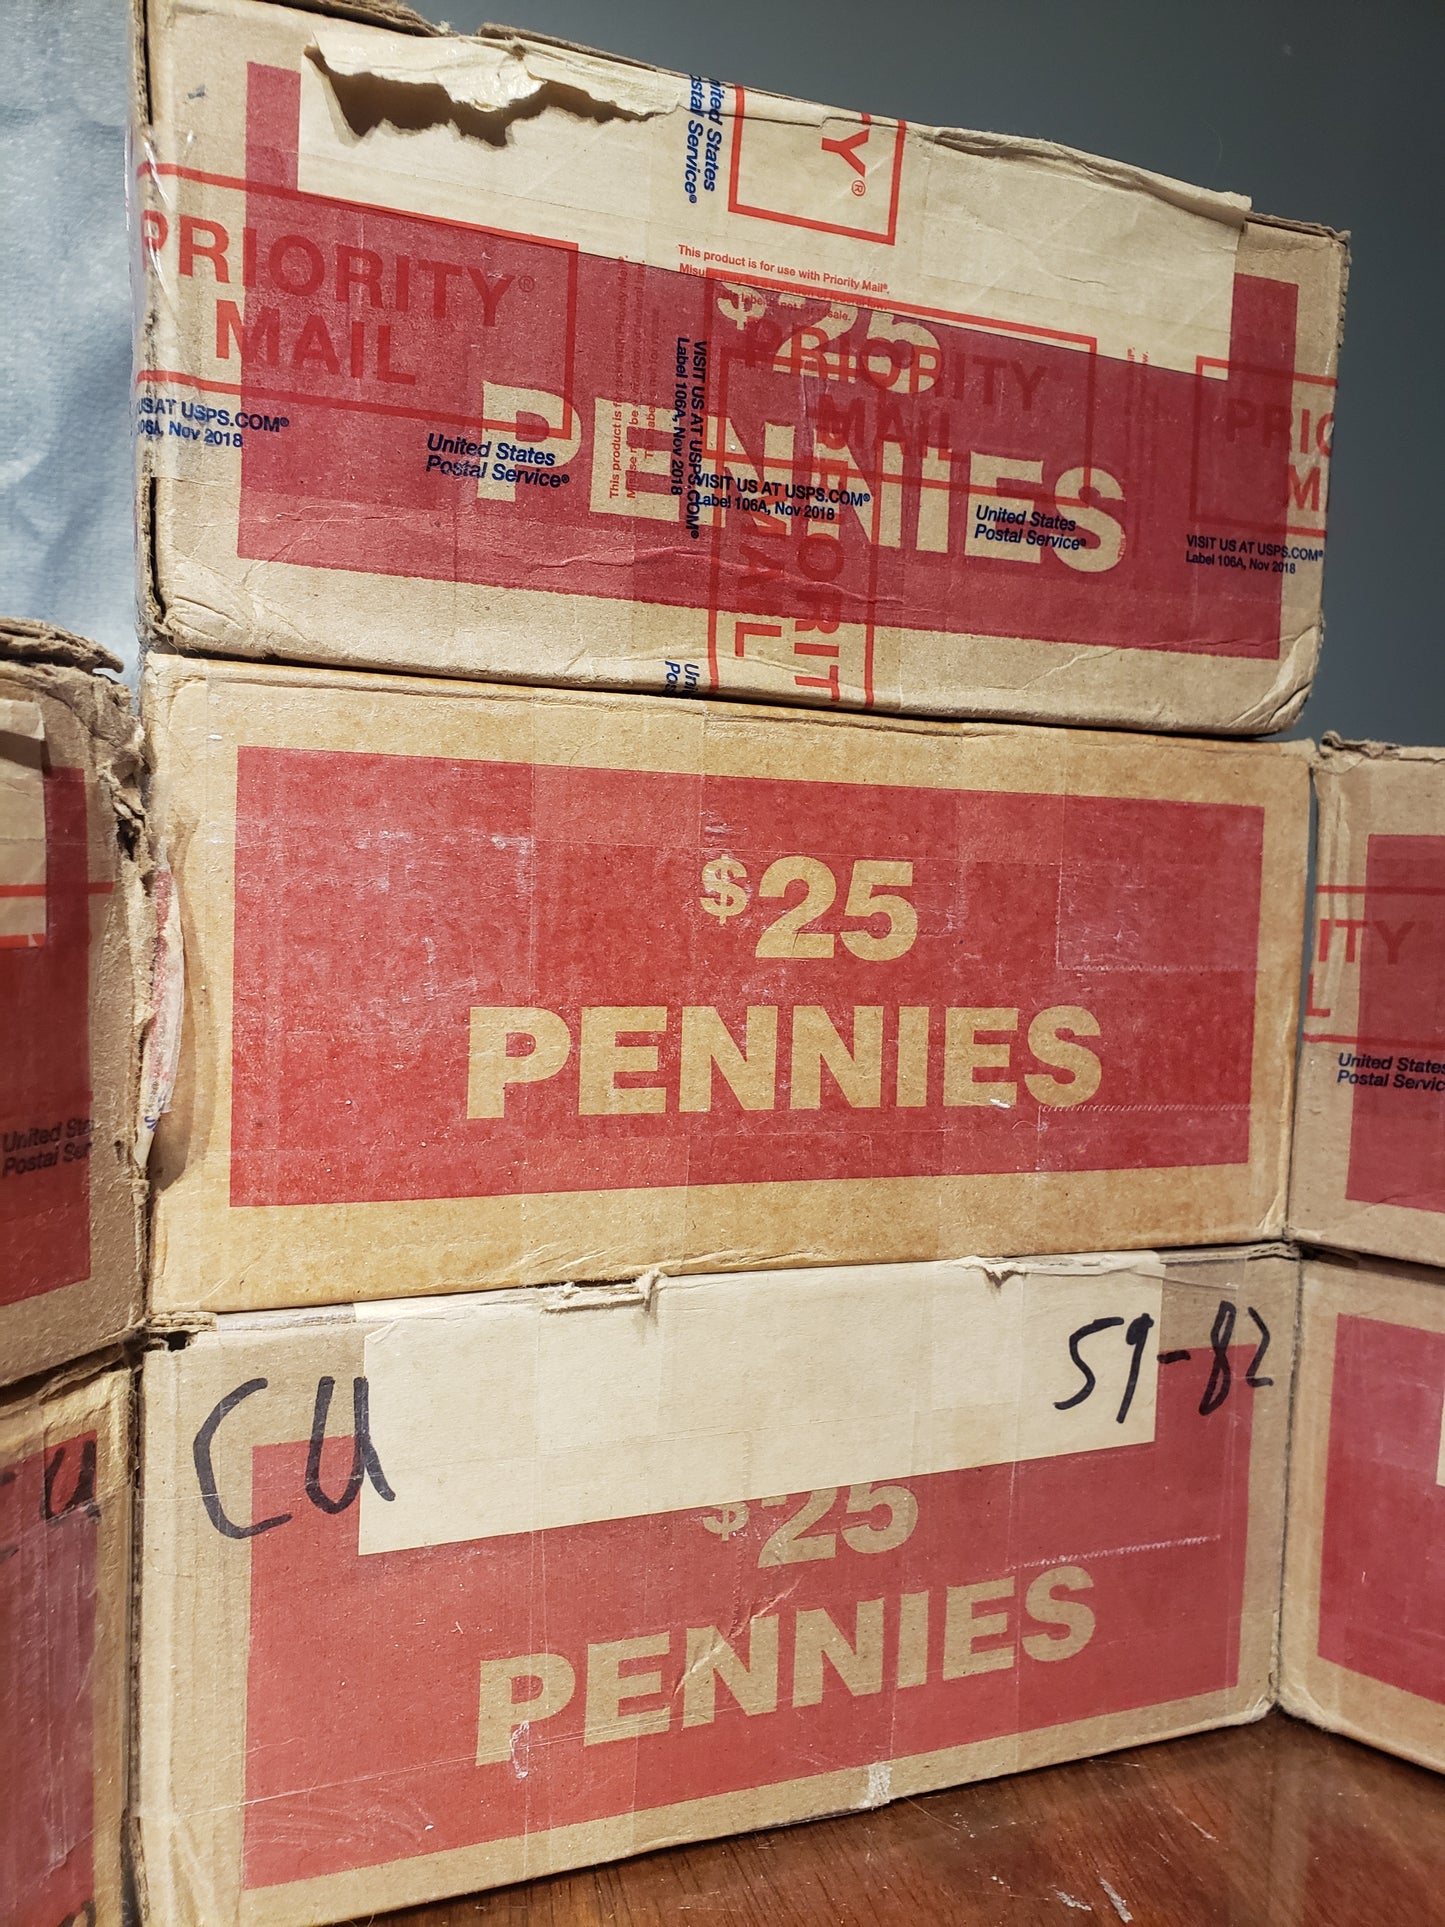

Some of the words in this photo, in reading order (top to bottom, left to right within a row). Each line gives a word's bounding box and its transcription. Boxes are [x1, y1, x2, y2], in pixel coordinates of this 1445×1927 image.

[703, 128, 722, 192] States
[679, 244, 701, 258] This
[703, 251, 746, 269] product
[748, 257, 757, 269] is
[759, 259, 775, 272] for
[777, 264, 796, 276] use
[798, 268, 821, 282] with
[823, 273, 860, 291] Priority
[216, 299, 416, 386] MAIL
[675, 337, 690, 379] Label
[693, 341, 707, 383] VISIT
[672, 382, 687, 422] 106A,
[691, 386, 705, 409] US
[612, 411, 622, 421] is
[690, 413, 703, 438] AT
[169, 420, 200, 440] Nov
[203, 428, 244, 448] 2018
[427, 432, 492, 458] United
[495, 442, 556, 466] States
[611, 423, 622, 471] product
[673, 426, 686, 457] Nov
[425, 454, 488, 479] Postal
[477, 381, 1126, 573] PENNIES
[671, 460, 684, 496] 2018
[610, 474, 620, 499] This
[698, 472, 735, 490] VISIT
[737, 478, 757, 494] US
[761, 481, 782, 497] AT
[698, 493, 731, 509] Label
[735, 496, 771, 516] 106A,
[774, 502, 801, 516] Nov
[803, 505, 835, 521] 2018
[976, 504, 1027, 525] United
[1029, 511, 1076, 532] States
[974, 523, 1023, 543] Postal
[1186, 534, 1216, 550] VISIT
[1219, 537, 1237, 552] US
[1238, 540, 1256, 554] AT
[1185, 549, 1216, 567] Label
[1218, 553, 1246, 571] 106A,
[1248, 556, 1271, 571] Nov
[1272, 559, 1297, 575] 2018
[700, 854, 920, 962] $25
[467, 1005, 1103, 1119] PENNIES
[1338, 1052, 1393, 1070] United
[1337, 1069, 1389, 1087] Postal
[2, 1120, 62, 1153] United
[2, 1147, 60, 1178] Postal
[475, 1566, 1096, 1768] PENNIES
